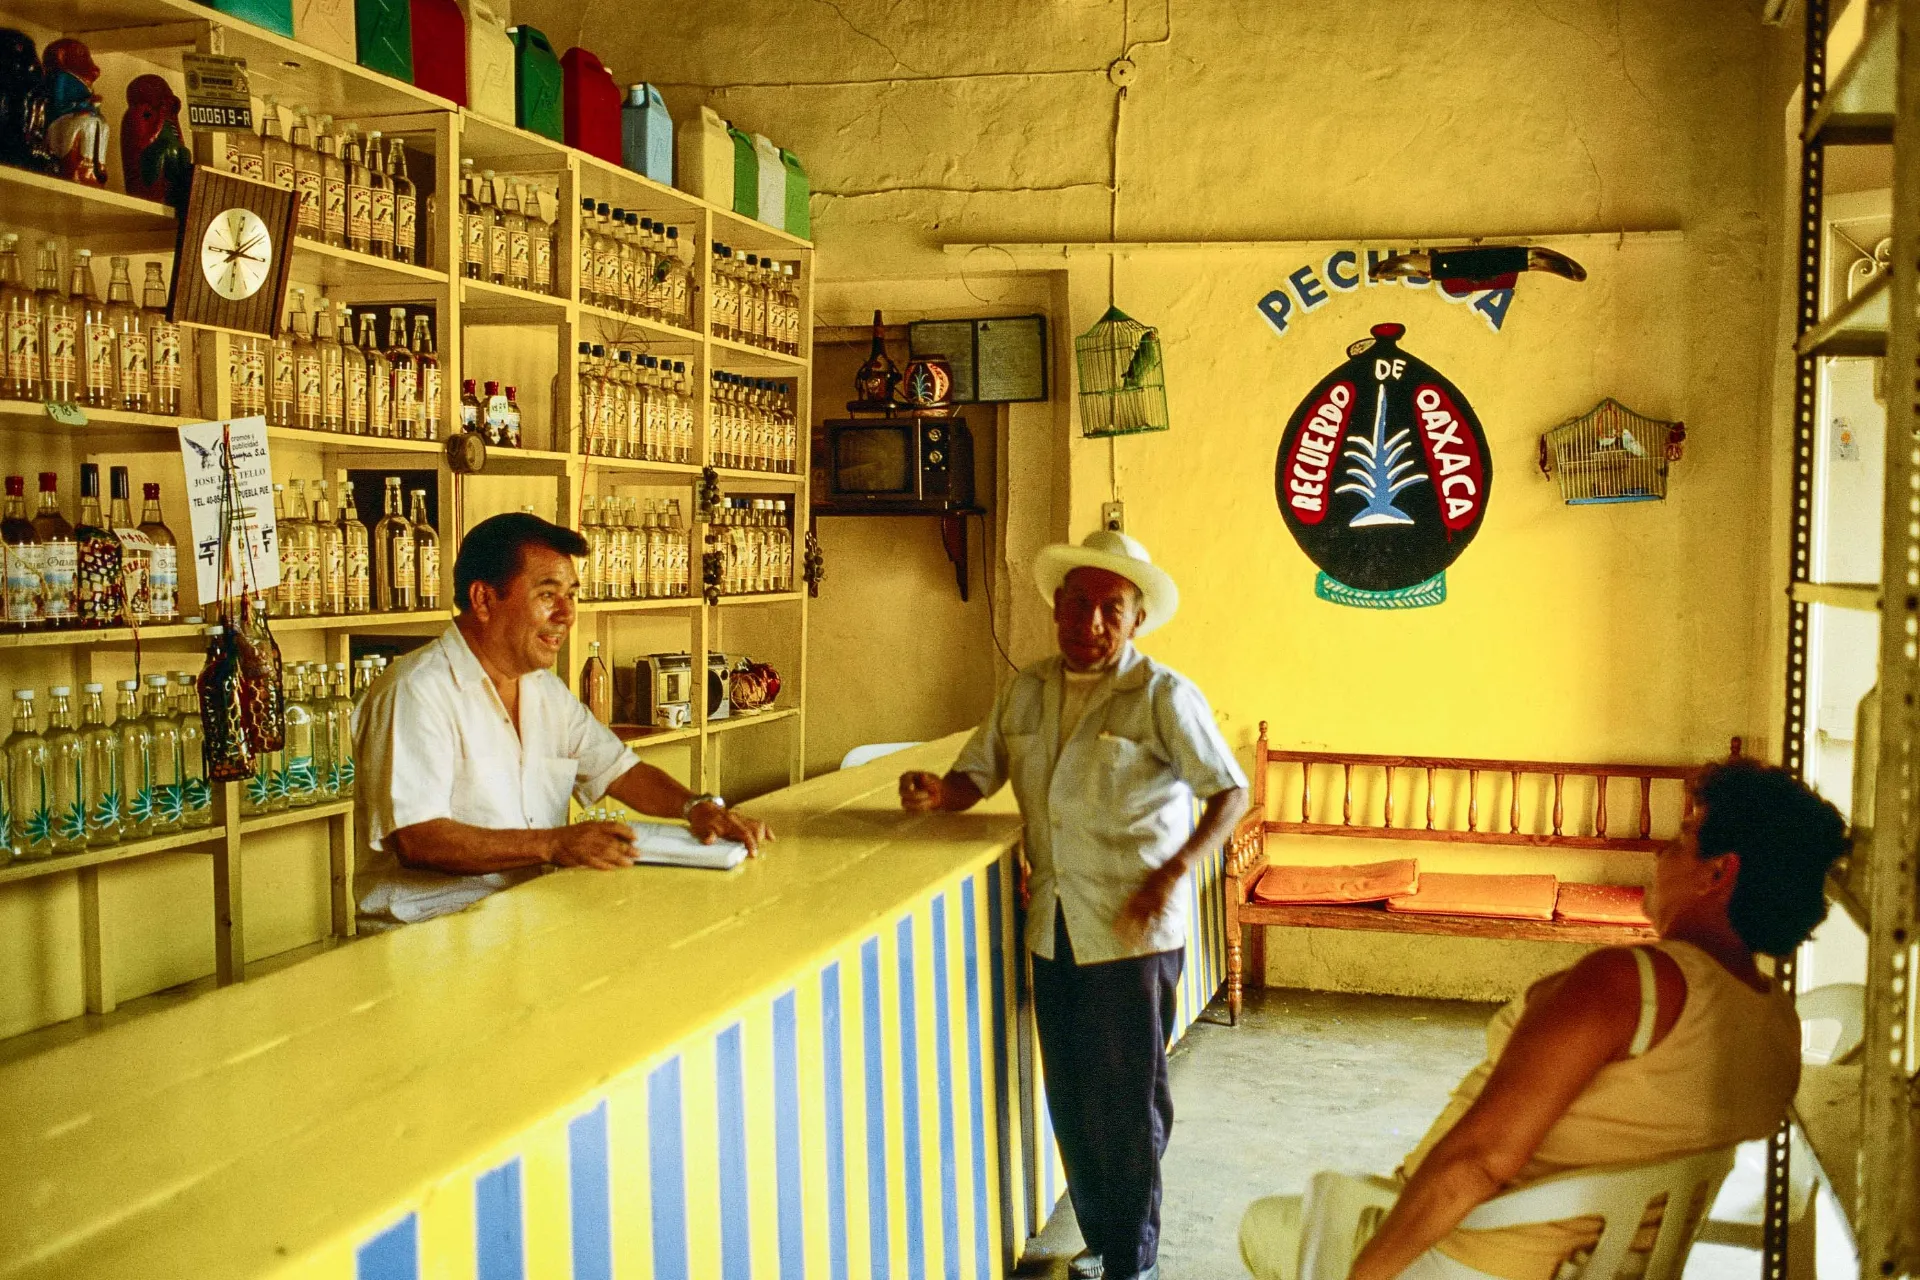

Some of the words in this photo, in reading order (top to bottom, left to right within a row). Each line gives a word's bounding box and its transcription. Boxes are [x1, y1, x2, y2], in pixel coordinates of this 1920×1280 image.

[190, 106, 251, 126] 000619-R
[1291, 385, 1350, 511] RECUERDO
[1375, 359, 1407, 381] DE
[1416, 389, 1476, 520] OAXACA
[194, 474, 218, 488] JOSE
[239, 468, 266, 480] TELLO
